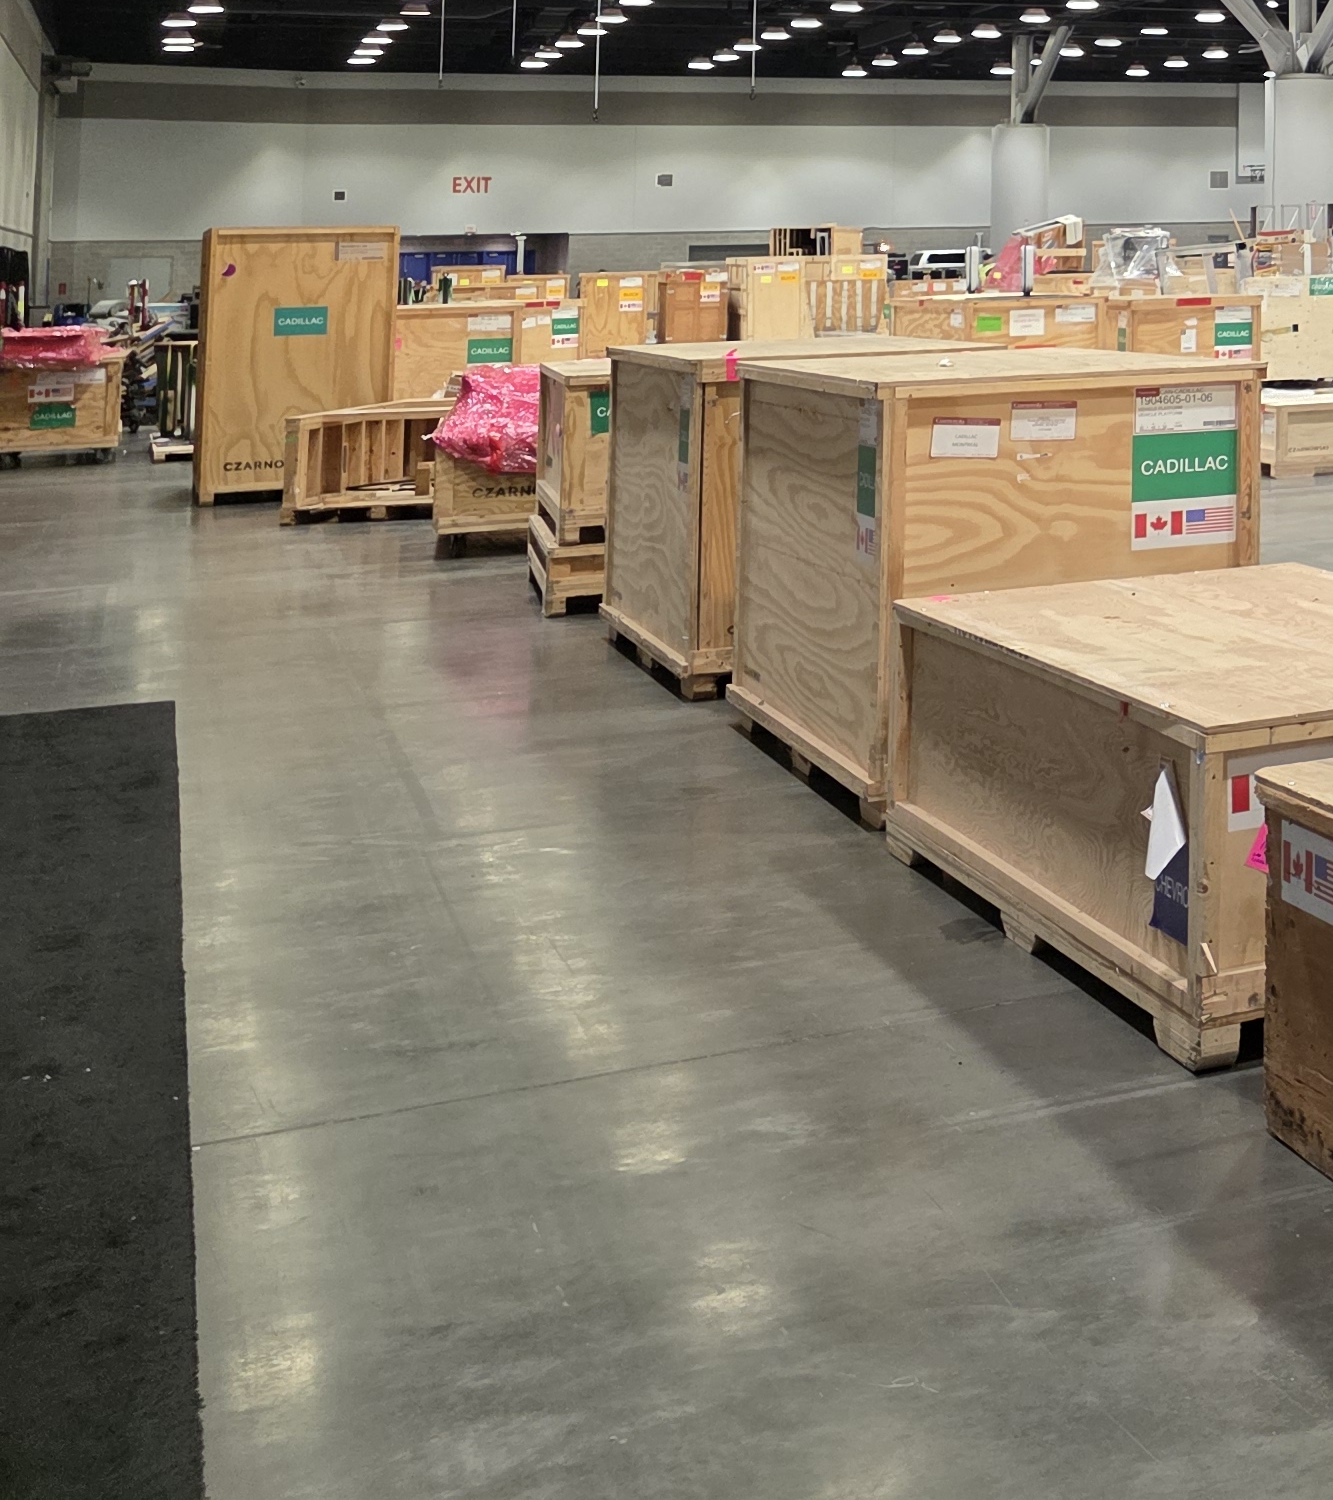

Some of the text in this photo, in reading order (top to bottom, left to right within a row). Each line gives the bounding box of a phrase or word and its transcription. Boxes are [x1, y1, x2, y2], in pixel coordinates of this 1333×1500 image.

[452, 176, 492, 193] EXIT
[278, 316, 324, 326] CADILLAC
[1217, 329, 1250, 338] CADILLAC
[471, 347, 509, 355] CADILLAC
[33, 411, 73, 420] CADILLAC
[1141, 455, 1228, 475] CADILLAC
